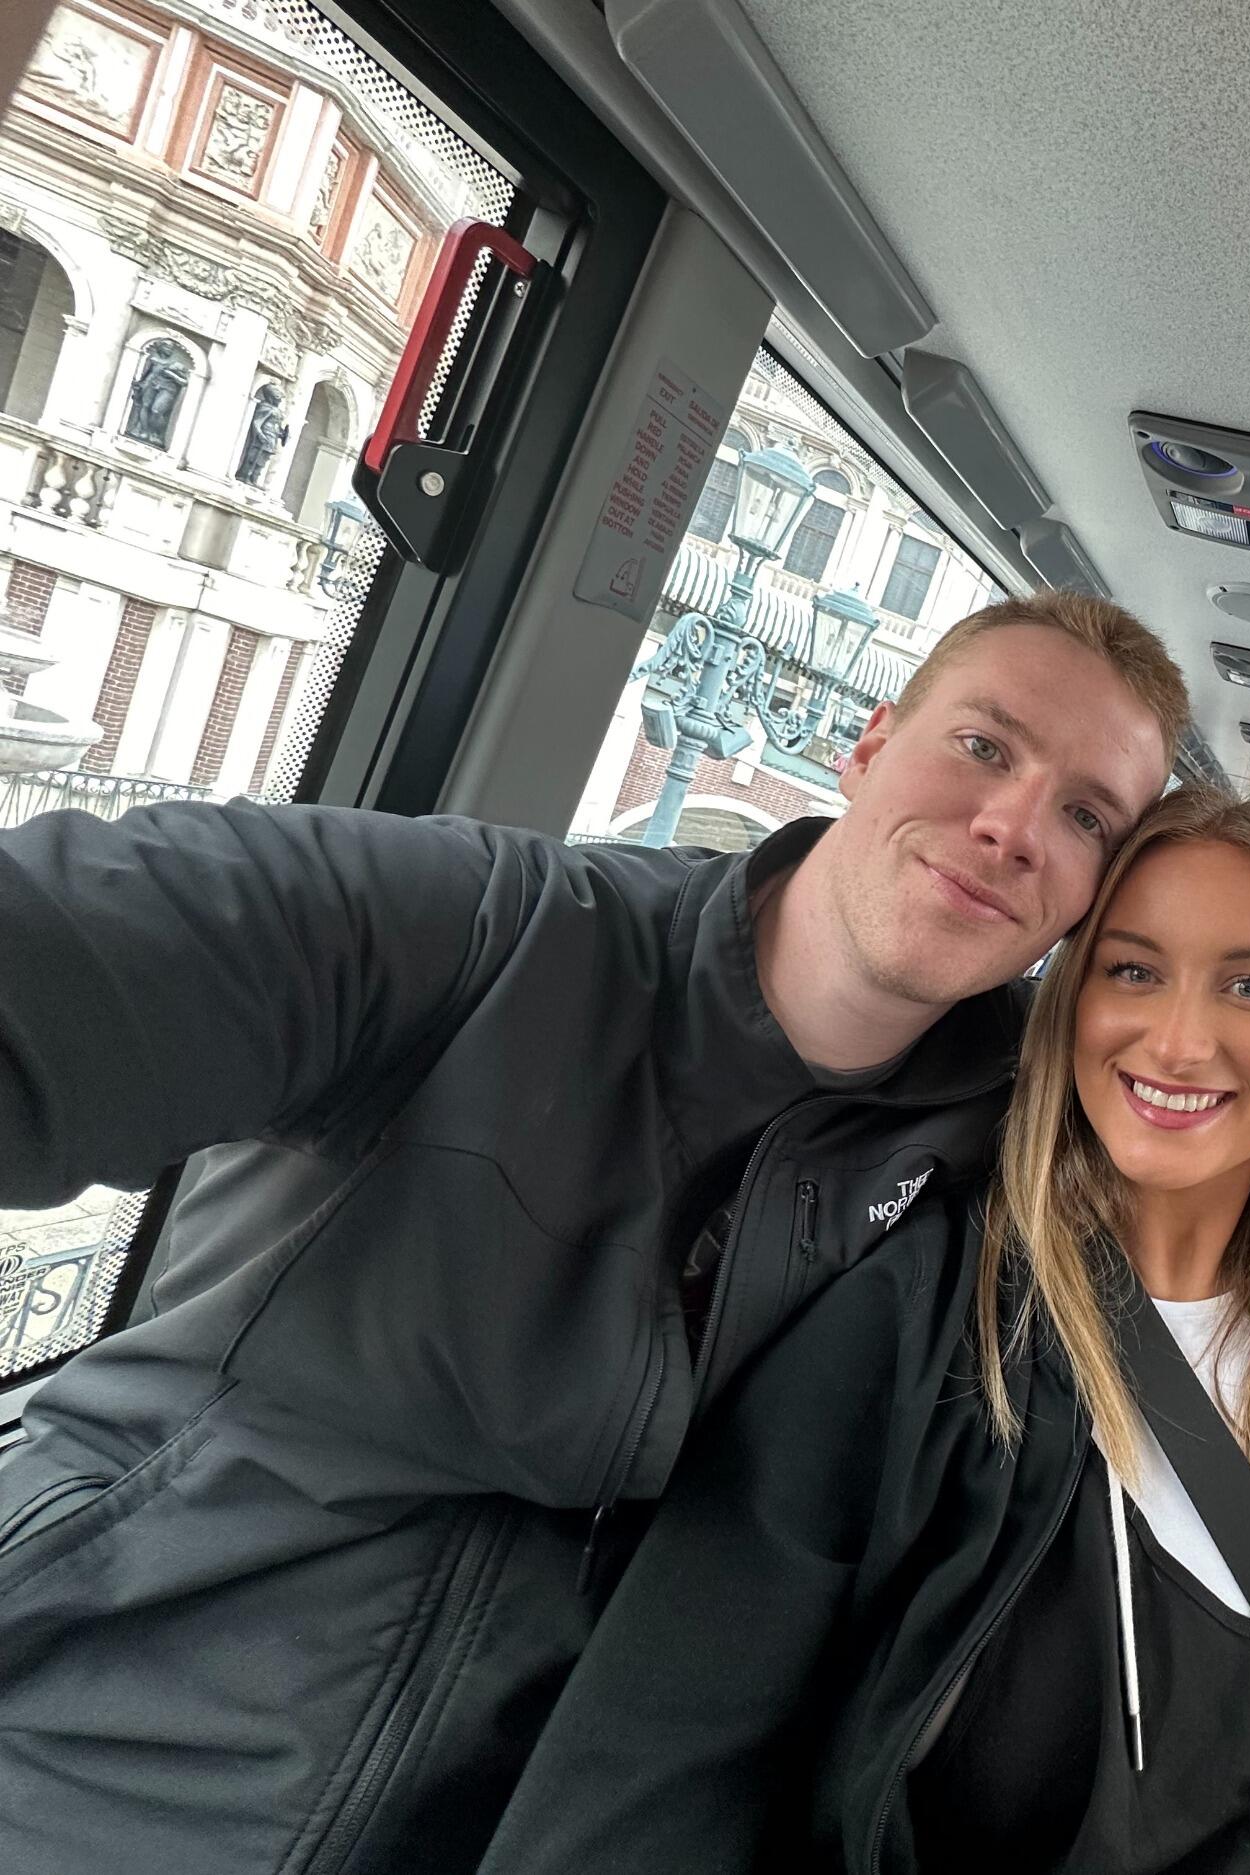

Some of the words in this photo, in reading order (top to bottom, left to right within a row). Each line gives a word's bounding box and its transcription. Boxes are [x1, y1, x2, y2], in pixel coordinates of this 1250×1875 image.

[660, 387, 676, 404] EXIT
[650, 409, 667, 428] PULL
[636, 428, 665, 454] HANDLE
[647, 422, 662, 438] RED
[632, 455, 650, 471] AND
[635, 441, 657, 463] DOWN
[627, 463, 648, 482] HOLD
[613, 481, 646, 507] PUSHING
[607, 505, 625, 521] OUT
[624, 516, 635, 527] AT
[609, 494, 641, 517] WINDOW
[602, 515, 634, 539] BOTTOM
